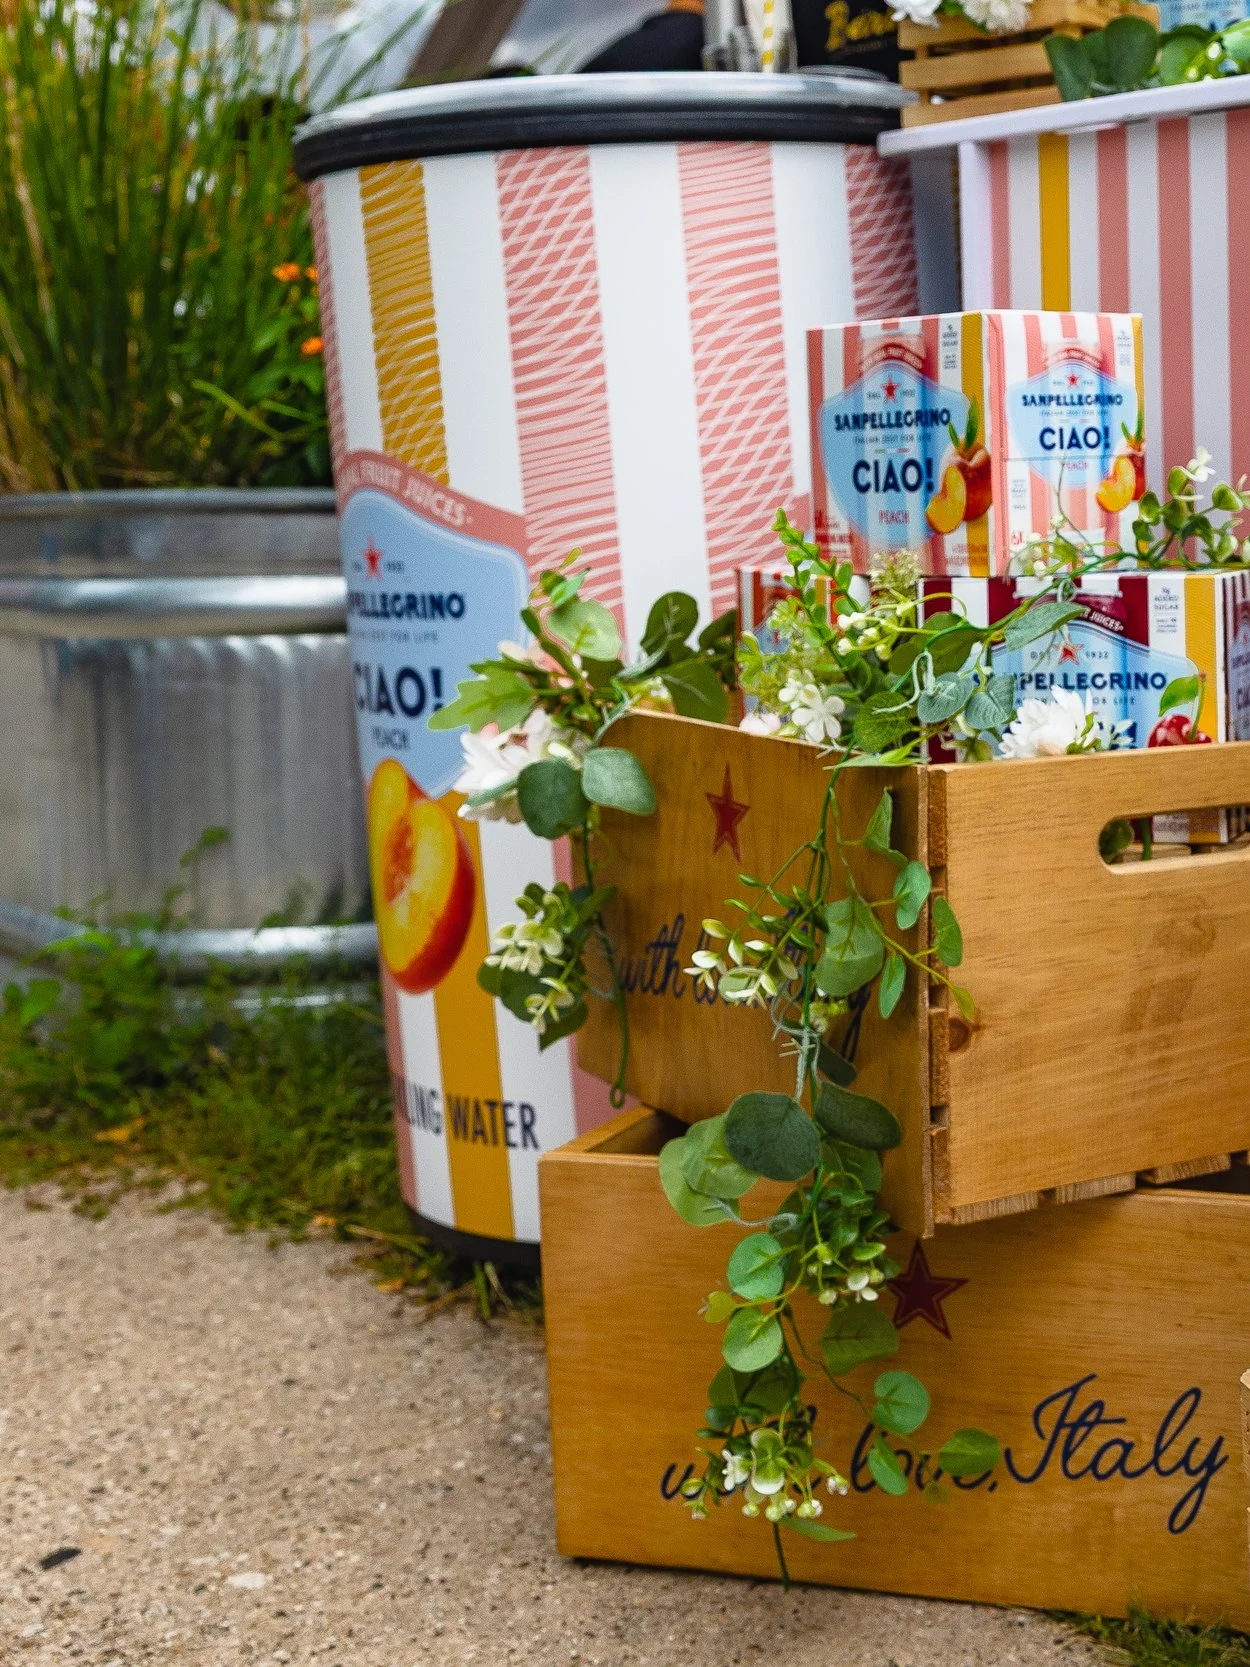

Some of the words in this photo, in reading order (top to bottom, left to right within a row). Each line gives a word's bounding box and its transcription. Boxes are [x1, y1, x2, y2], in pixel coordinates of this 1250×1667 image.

[834, 408, 951, 431] SANPELLEGRINO
[1039, 426, 1110, 450] CIAO!
[852, 458, 935, 494] CIAO!
[447, 1094, 540, 1150] WATER
[1004, 1373, 1229, 1536] Italy
